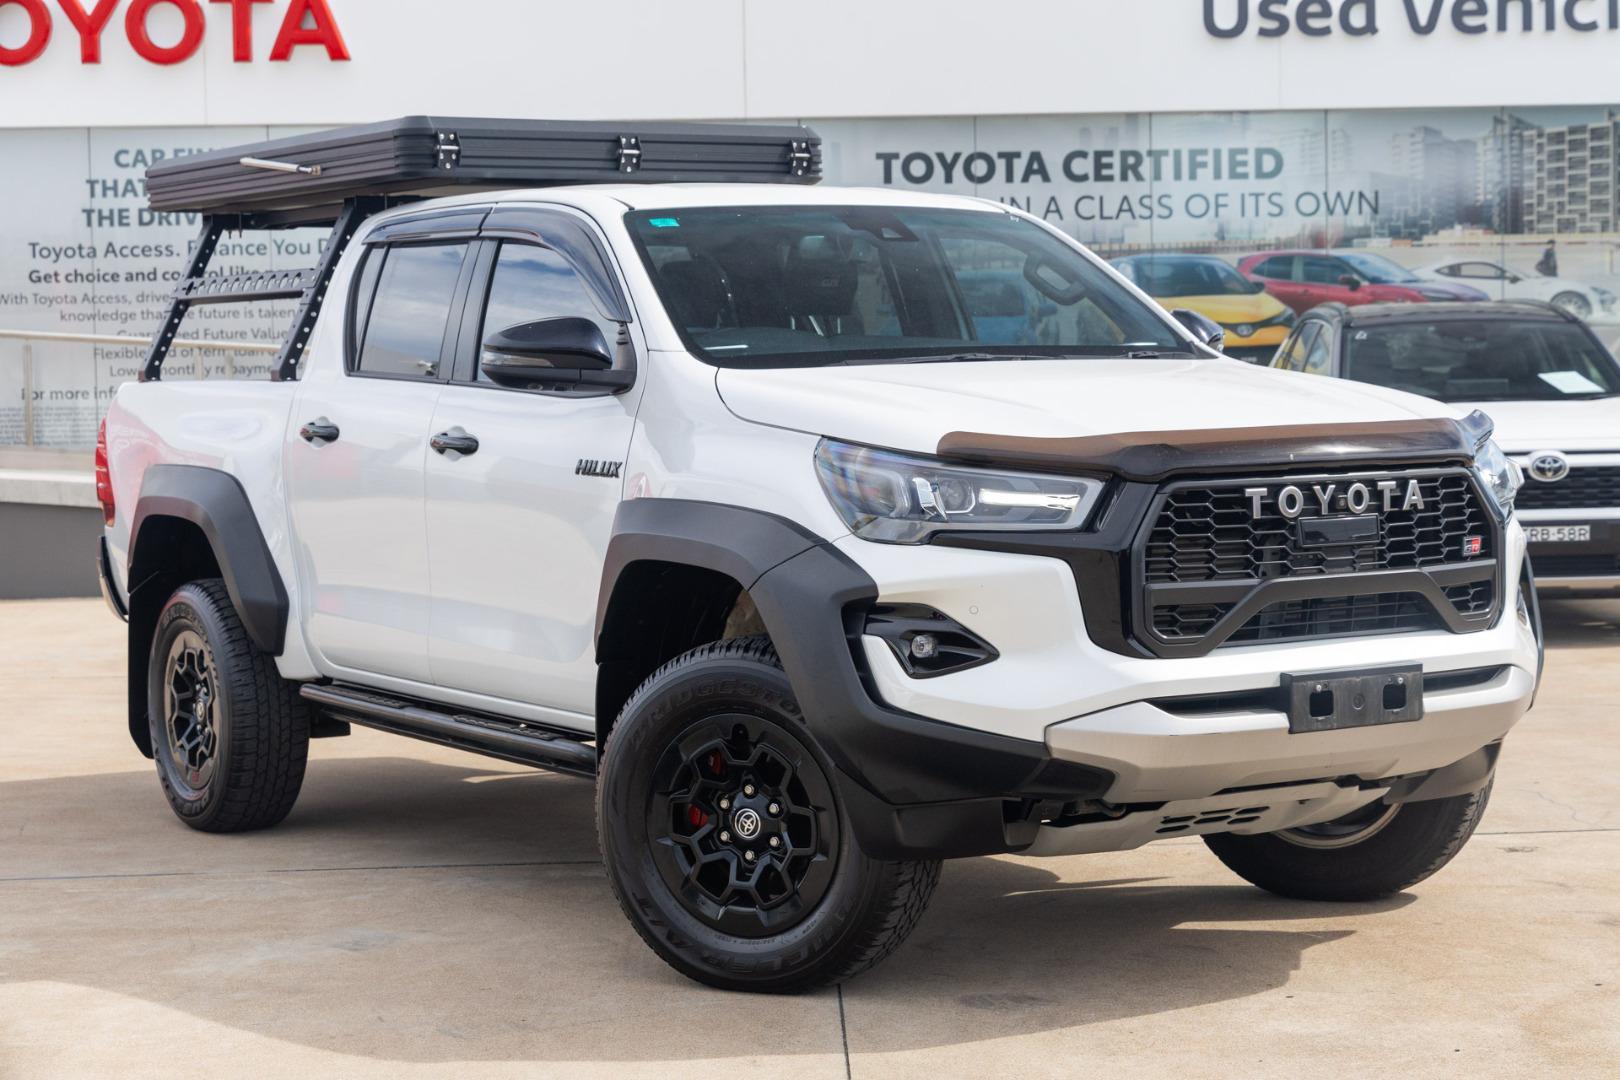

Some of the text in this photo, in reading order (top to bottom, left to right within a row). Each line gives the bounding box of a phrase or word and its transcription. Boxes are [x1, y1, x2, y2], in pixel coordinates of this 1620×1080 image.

[1202, 0, 1379, 39] Used
[876, 148, 1284, 185] TOYOTA CERTIFIED
[1043, 195, 1064, 220] A
[1074, 194, 1173, 220] CLASS
[1184, 193, 1229, 219] OF
[1240, 192, 1284, 218] ITS
[1295, 190, 1379, 217] OWN
[82, 208, 131, 228] THE
[28, 242, 97, 263] Toyota
[104, 241, 181, 258] Access.
[273, 238, 311, 255] You
[29, 270, 61, 284] Get
[64, 269, 120, 284] choice
[124, 267, 157, 282] and
[32, 292, 78, 307] Toyota
[60, 309, 137, 324] knowledge
[199, 308, 240, 319] future
[244, 308, 254, 319] is
[204, 328, 249, 340] Future
[49, 389, 90, 400] more
[575, 458, 623, 479] HILUX
[1244, 478, 1425, 520] TOYOTA
